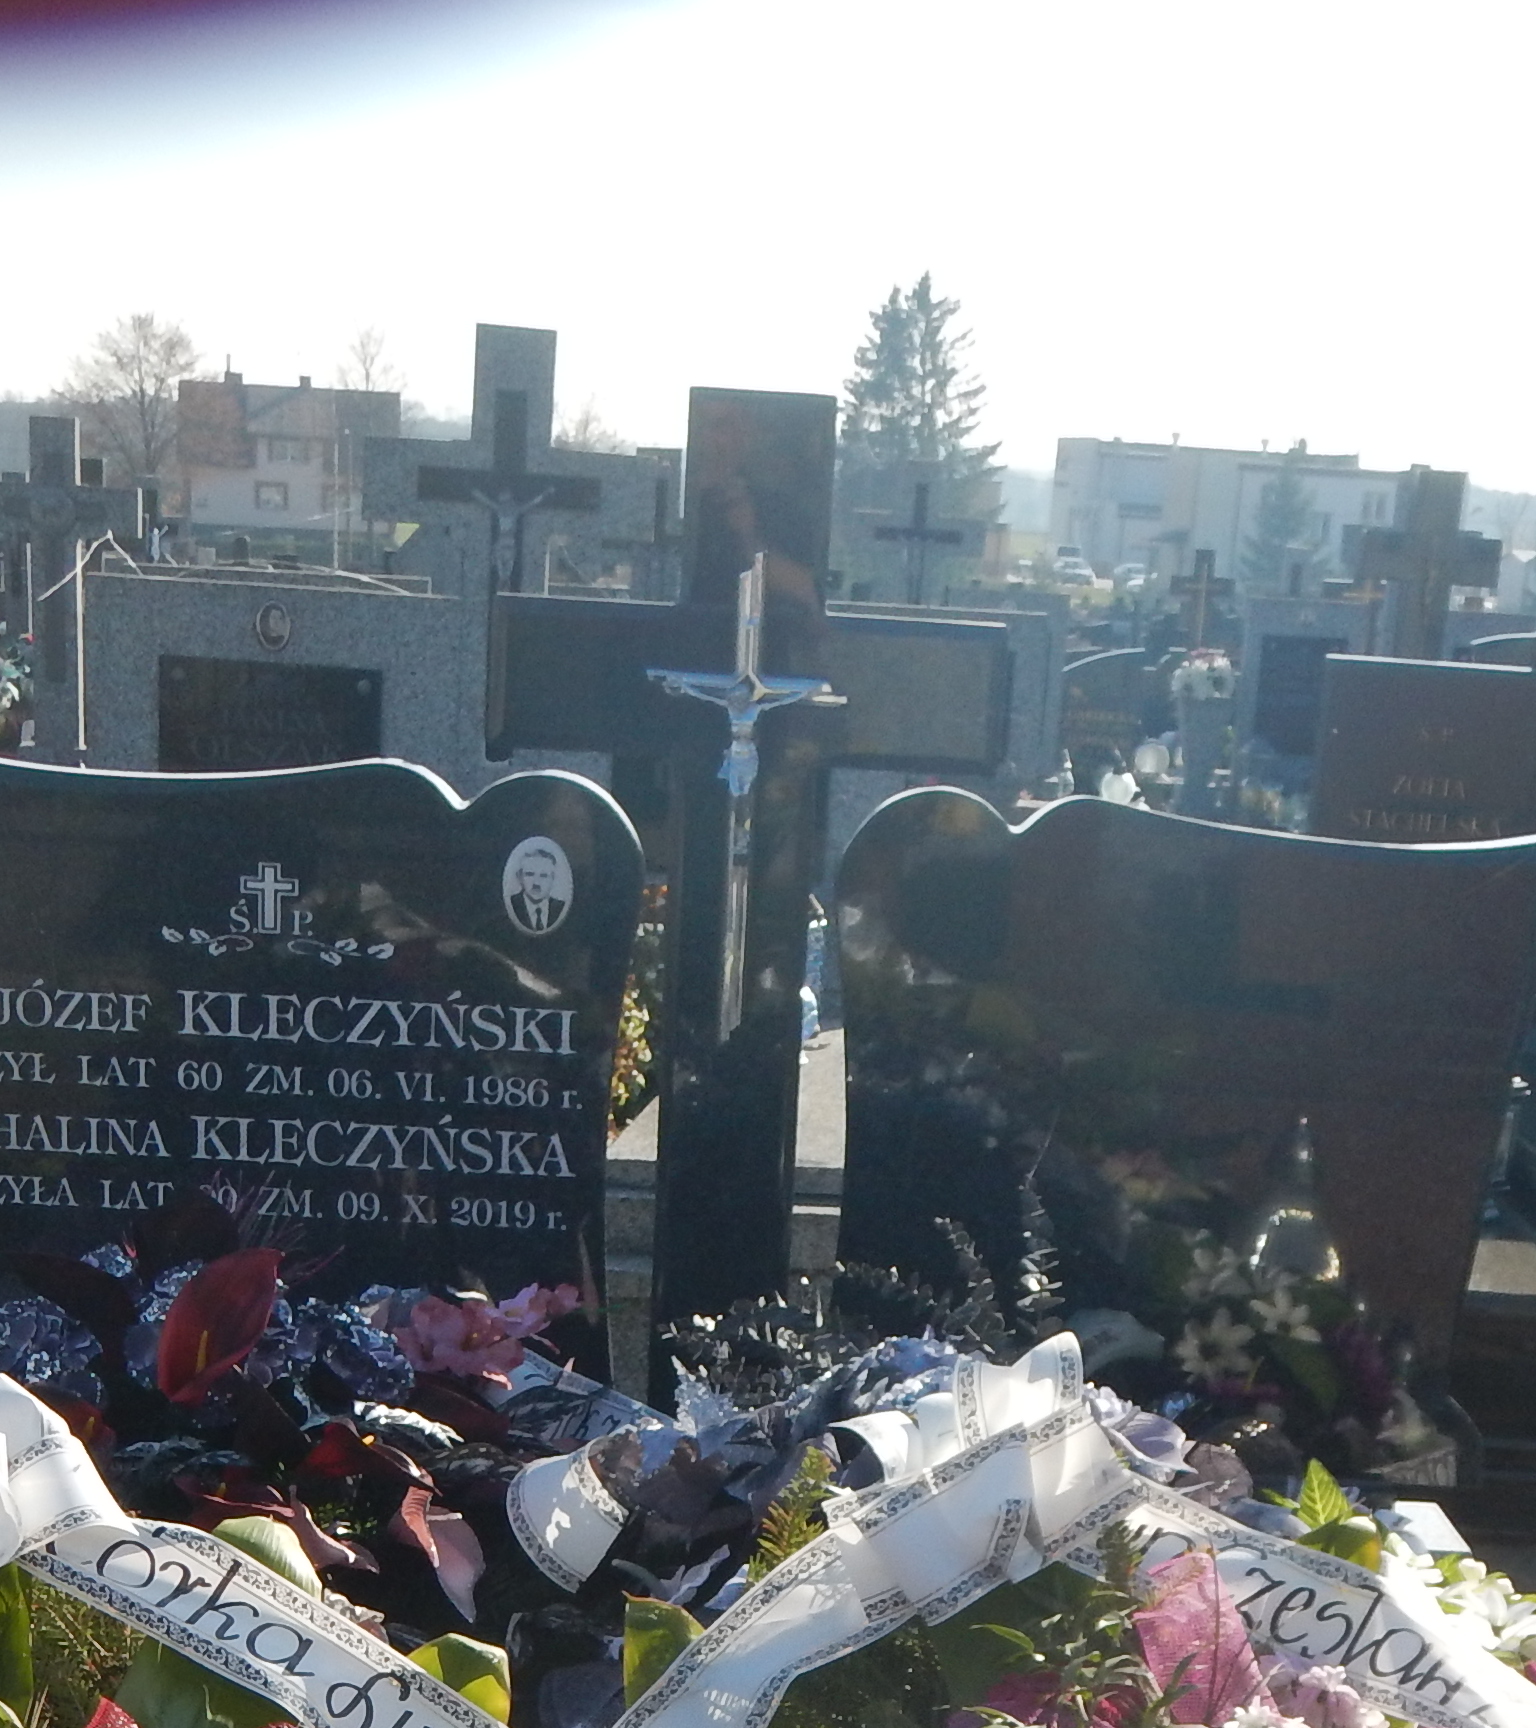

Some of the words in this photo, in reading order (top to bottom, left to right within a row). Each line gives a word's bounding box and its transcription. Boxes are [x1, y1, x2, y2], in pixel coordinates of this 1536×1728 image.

[177, 989, 577, 1056] KLECZYŃSKI
[77, 1052, 157, 1089] LAT
[177, 1060, 223, 1091] 60
[246, 1063, 315, 1097] ZM.
[328, 1068, 381, 1100] 06.
[398, 1070, 446, 1102] VI.
[464, 1075, 549, 1109] 1986
[560, 1088, 583, 1110] r.
[191, 1114, 577, 1178] KLECZYŃSKA
[100, 1179, 175, 1211] LAT
[258, 1187, 324, 1220] ZM.
[337, 1190, 388, 1222] 09.
[401, 1195, 437, 1225] X.
[450, 1198, 536, 1230] 2019
[546, 1210, 568, 1231] r.
